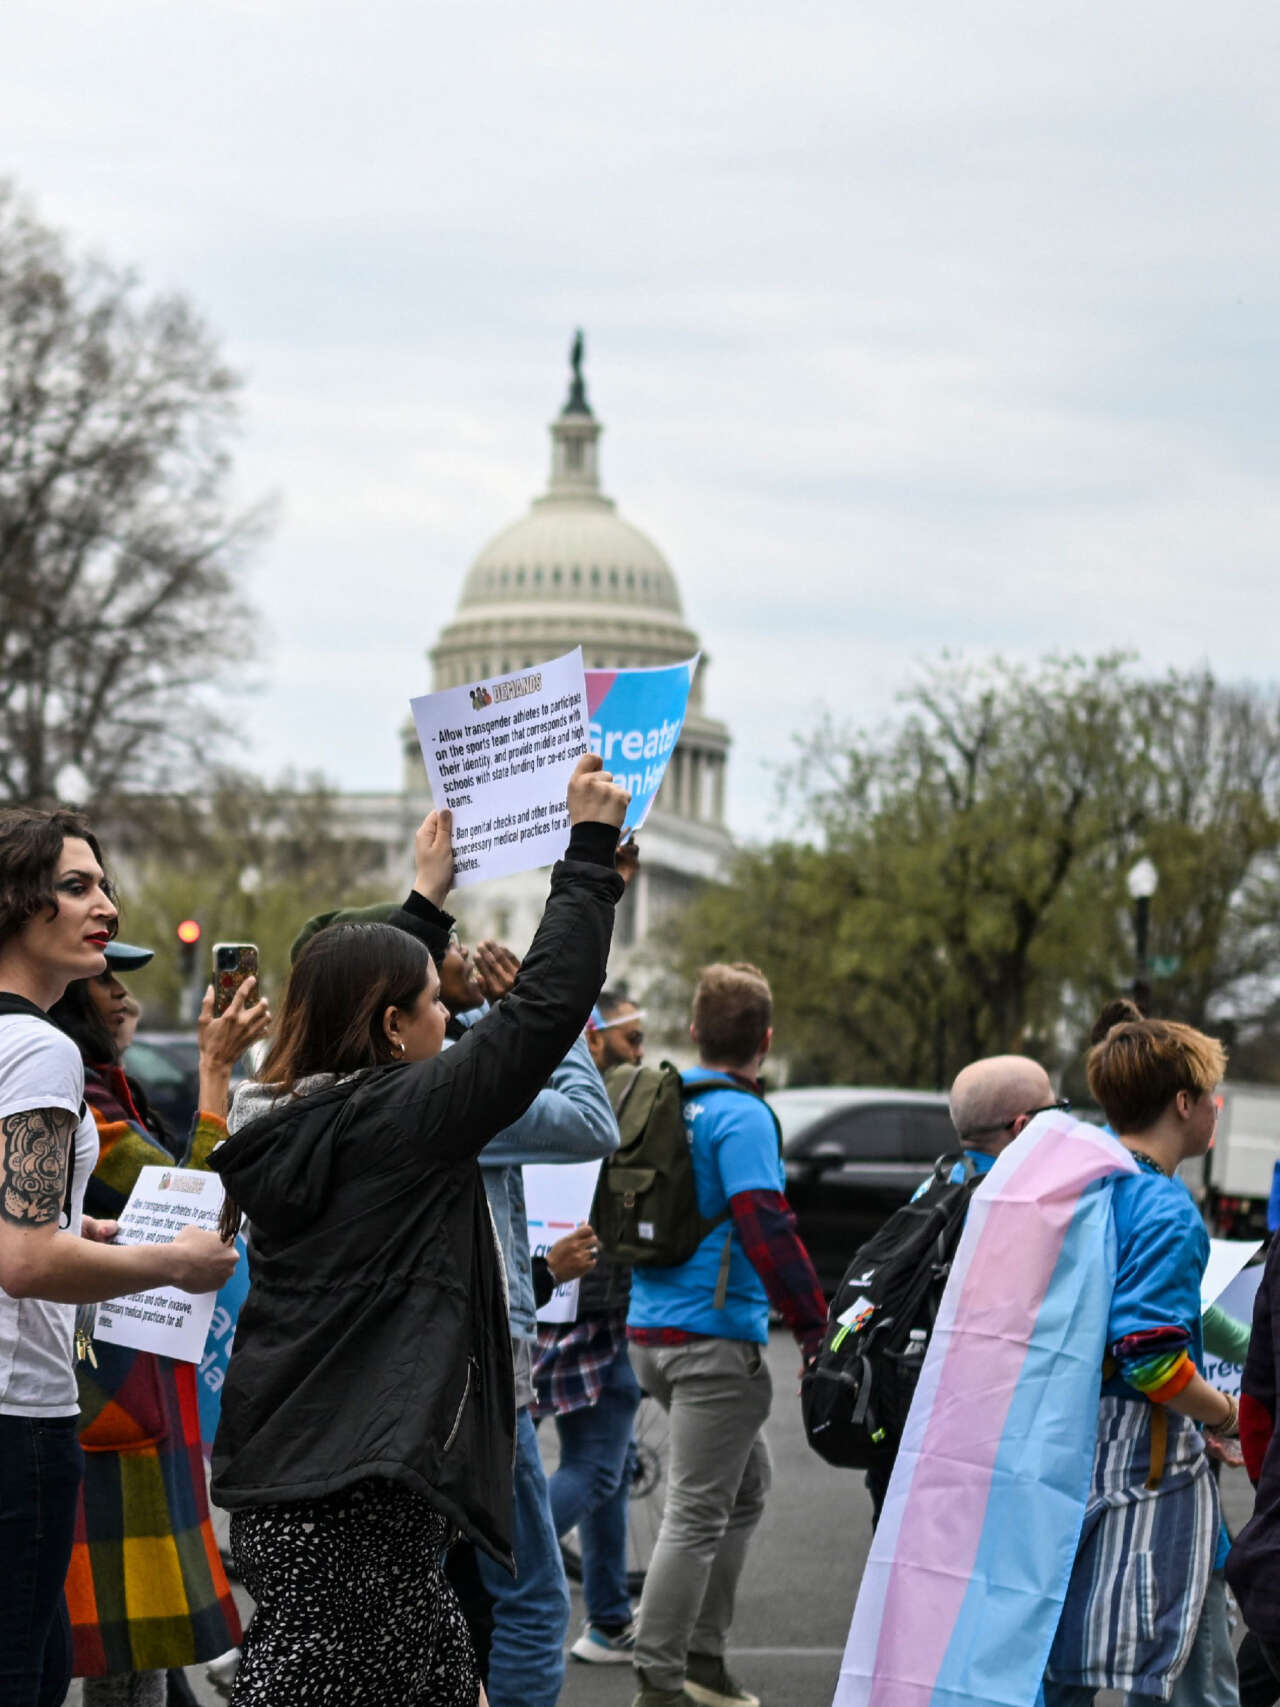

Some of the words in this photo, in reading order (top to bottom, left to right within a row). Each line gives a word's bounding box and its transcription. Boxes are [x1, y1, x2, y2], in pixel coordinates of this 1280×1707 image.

[492, 672, 542, 703] DEMANDS
[435, 750, 448, 761] on
[449, 744, 464, 757] the
[465, 738, 490, 754] sports
[492, 733, 510, 747] team
[512, 726, 525, 741] that
[527, 714, 567, 738] corresponds
[569, 708, 581, 723] with
[439, 729, 463, 743] Allow
[465, 715, 511, 737] transgender
[513, 707, 540, 725] athletes
[542, 704, 549, 715] to
[439, 761, 460, 776] their
[494, 749, 507, 763] and
[508, 741, 532, 762] provide
[534, 735, 556, 751] middle
[558, 729, 570, 744] and
[572, 725, 584, 742] high
[443, 775, 474, 793] schools
[476, 771, 490, 785] with
[492, 766, 509, 781] state
[511, 758, 535, 776] funding
[536, 755, 545, 768] for
[548, 747, 565, 765] co-ed
[568, 742, 587, 760] sports
[446, 795, 473, 809] teams.
[456, 827, 468, 840] Ban
[470, 818, 492, 840] genital
[493, 813, 516, 830] checks
[517, 808, 529, 824] and
[531, 805, 547, 820] other
[549, 800, 568, 815] invas
[494, 827, 519, 847] medical
[520, 822, 550, 844] practices
[551, 819, 561, 831] for
[166, 1313, 176, 1326] for
[175, 1315, 184, 1328] all
[168, 1297, 192, 1315] invasive,
